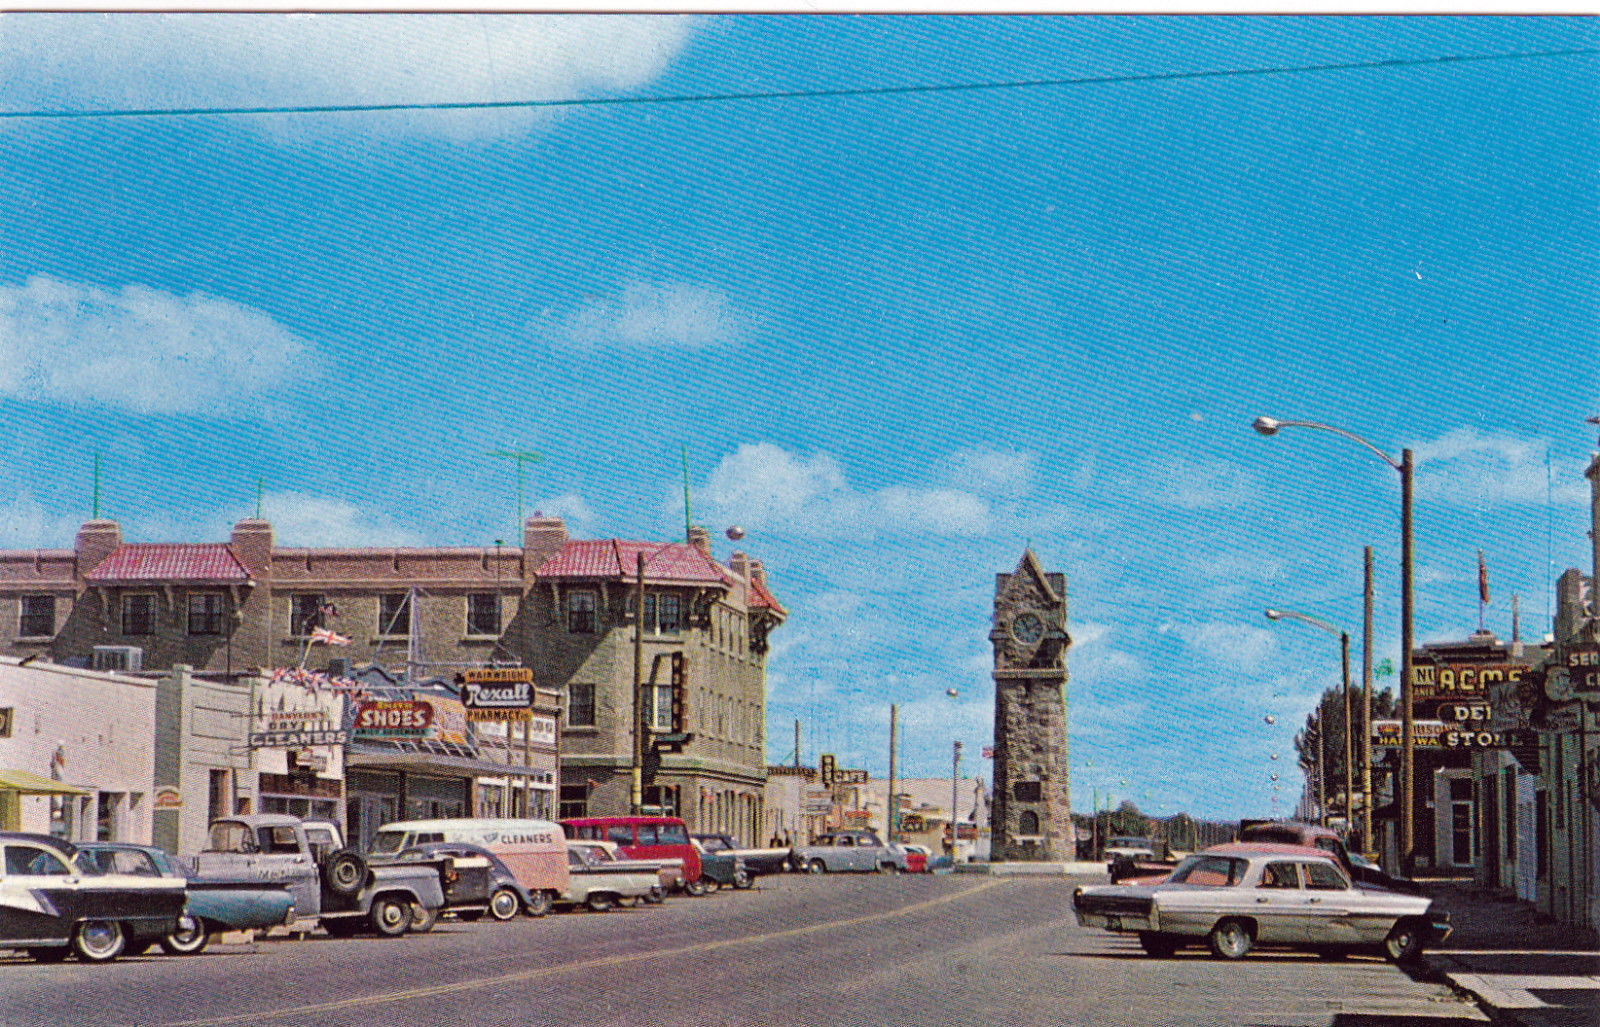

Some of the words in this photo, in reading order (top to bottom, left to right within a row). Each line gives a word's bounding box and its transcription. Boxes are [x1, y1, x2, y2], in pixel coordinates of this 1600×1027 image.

[466, 683, 531, 706] Rexall
[361, 709, 426, 727] SHOES
[467, 710, 523, 720] PHARMACY
[268, 721, 298, 730] DRY
[250, 730, 347, 745] CLEANERS
[500, 834, 552, 844] CLEANERS
